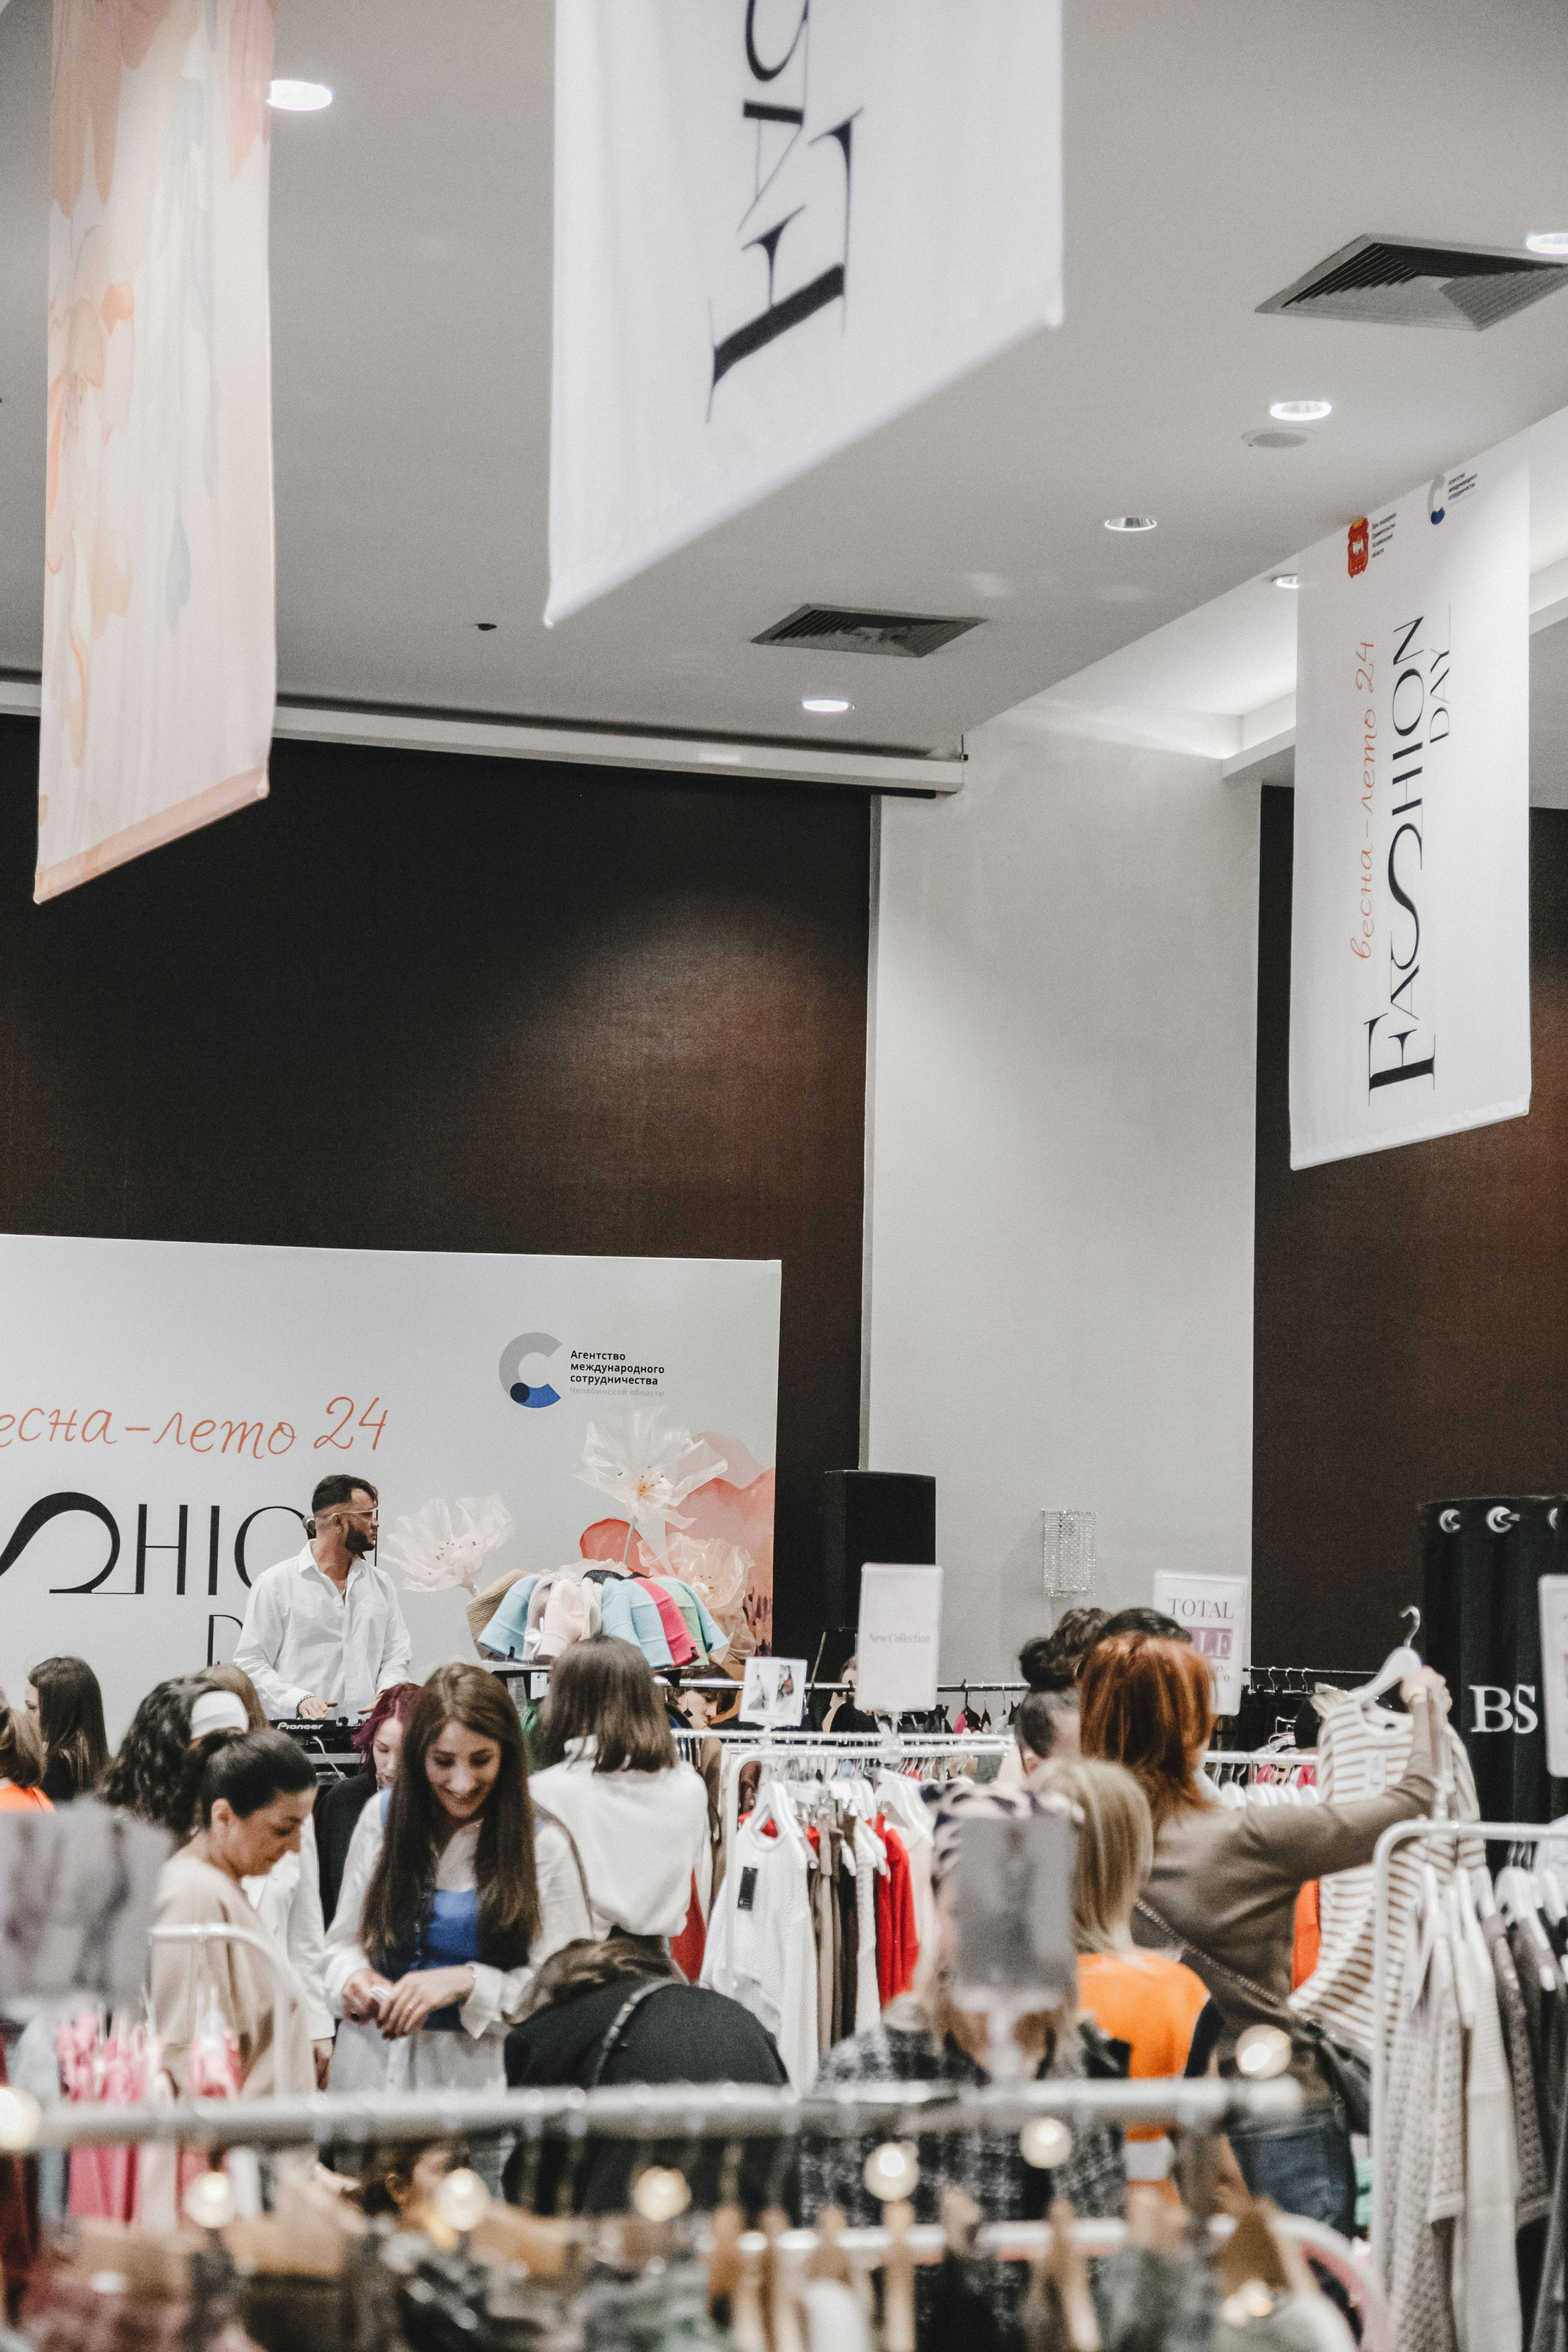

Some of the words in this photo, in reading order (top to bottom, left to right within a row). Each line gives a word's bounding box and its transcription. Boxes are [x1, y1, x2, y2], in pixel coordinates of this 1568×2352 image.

[1355, 641, 1374, 694] 24
[1429, 602, 1450, 744] DAY
[1349, 709, 1378, 959] весна-лето
[1363, 616, 1436, 1107] FASHION
[570, 1350, 626, 1361] Агентство
[570, 1363, 665, 1374] международного
[570, 1374, 658, 1385] сотрудничества
[570, 1387, 627, 1396] Челябинской
[630, 1389, 665, 1397] области
[313, 1396, 388, 1451] 24
[1168, 1597, 1234, 1619] TOTAL
[277, 1722, 324, 1730] Pioneer
[1469, 1683, 1539, 1734] BS
